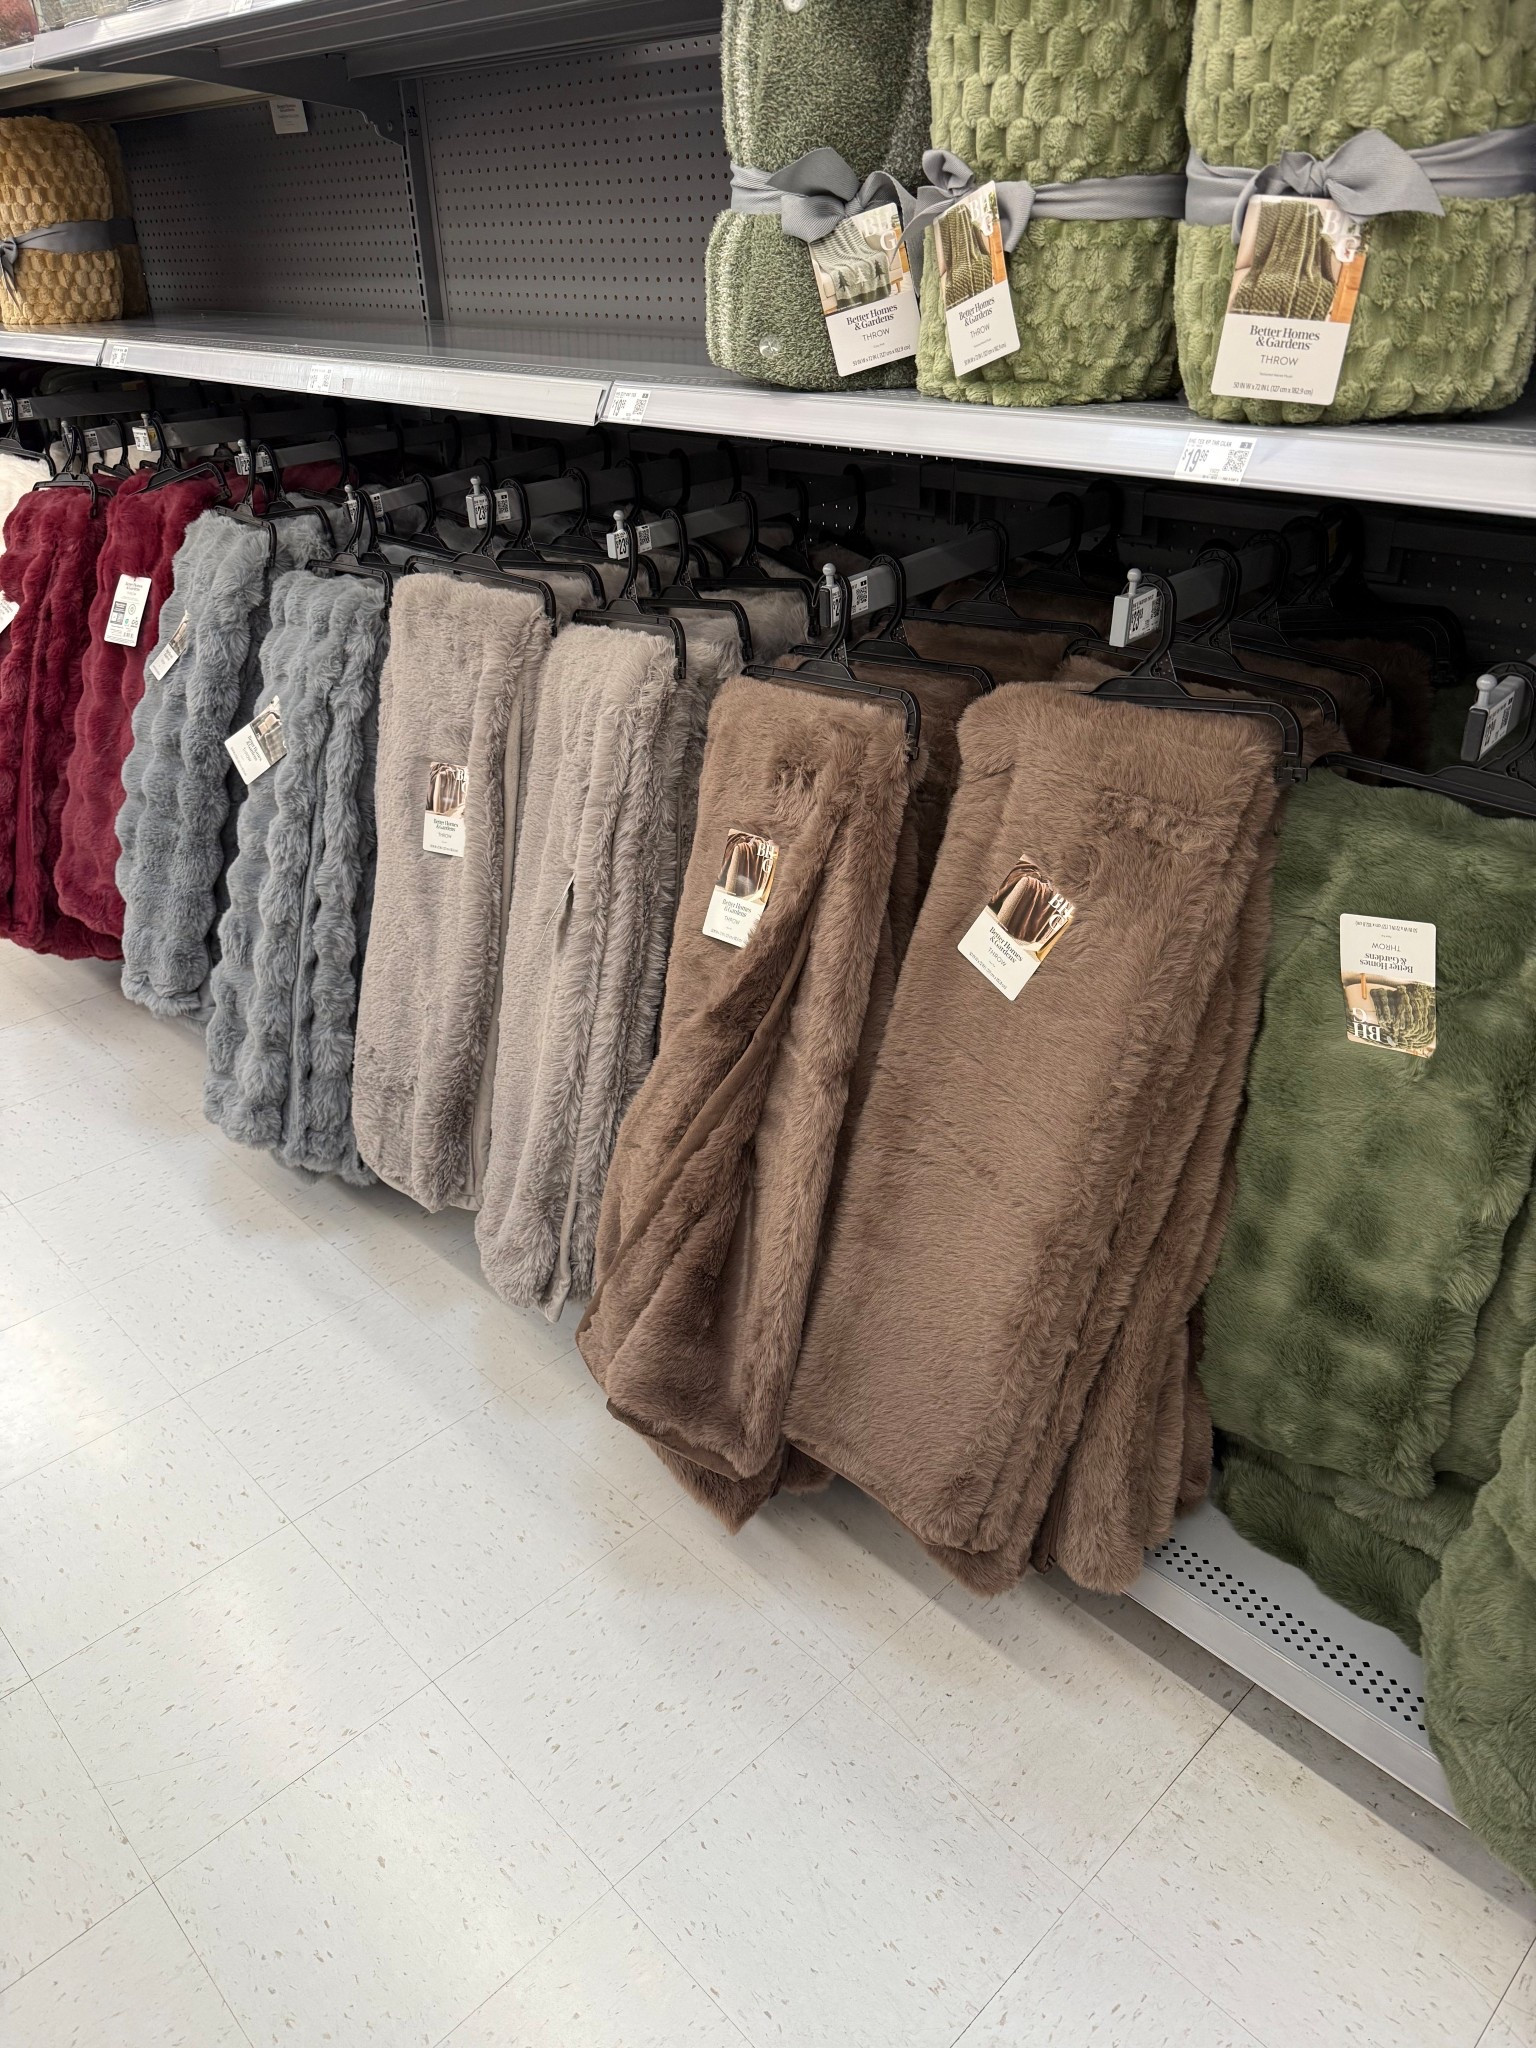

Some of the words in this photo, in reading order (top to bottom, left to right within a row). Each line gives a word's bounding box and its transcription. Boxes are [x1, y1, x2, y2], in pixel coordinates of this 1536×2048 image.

[846, 312, 870, 325] Better
[871, 304, 897, 318] Homes
[959, 307, 975, 320] Better
[975, 297, 995, 313] Homes
[862, 328, 890, 341] THROW
[970, 323, 990, 338] THROW
[1250, 325, 1282, 338] Better
[1283, 328, 1320, 341] Homes
[1260, 355, 1299, 366] THROW
[990, 926, 1005, 944] Better
[1004, 941, 1023, 962] Homes
[1372, 942, 1401, 952] THROW
[988, 947, 1007, 967] THROW
[1360, 959, 1387, 970] Homes
[1389, 963, 1413, 973] Better
